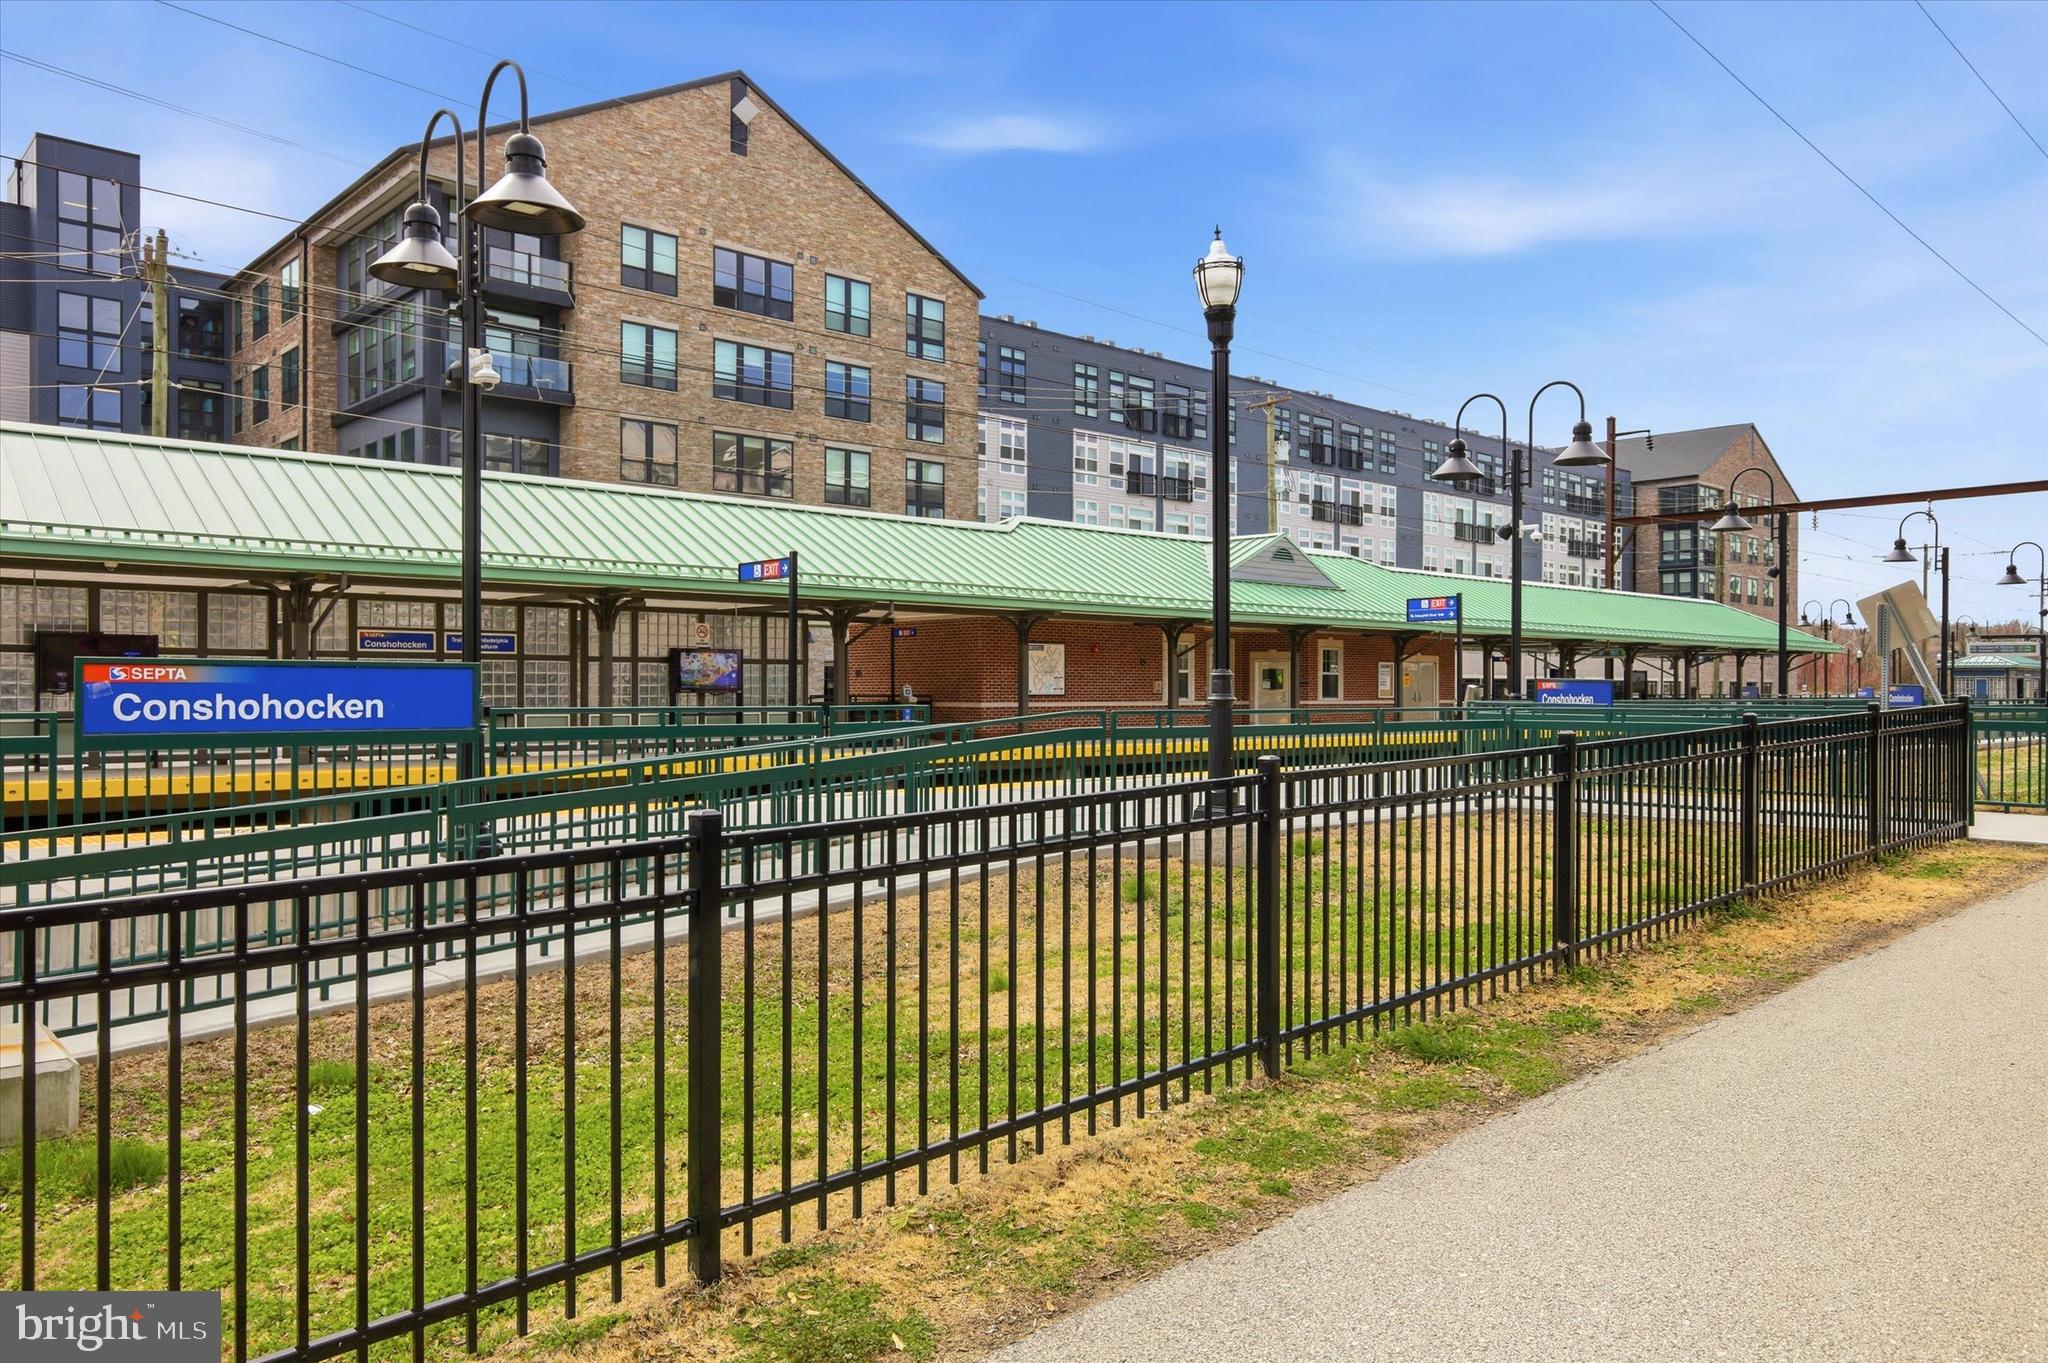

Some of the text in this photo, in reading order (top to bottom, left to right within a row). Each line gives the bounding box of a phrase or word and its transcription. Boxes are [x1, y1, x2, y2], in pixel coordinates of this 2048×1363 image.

[764, 562, 779, 576] EXIT
[1431, 599, 1446, 608] EXIT
[364, 640, 428, 649] Conshohocken
[130, 667, 187, 681] SEPTA
[112, 693, 385, 722] Conshohocken
